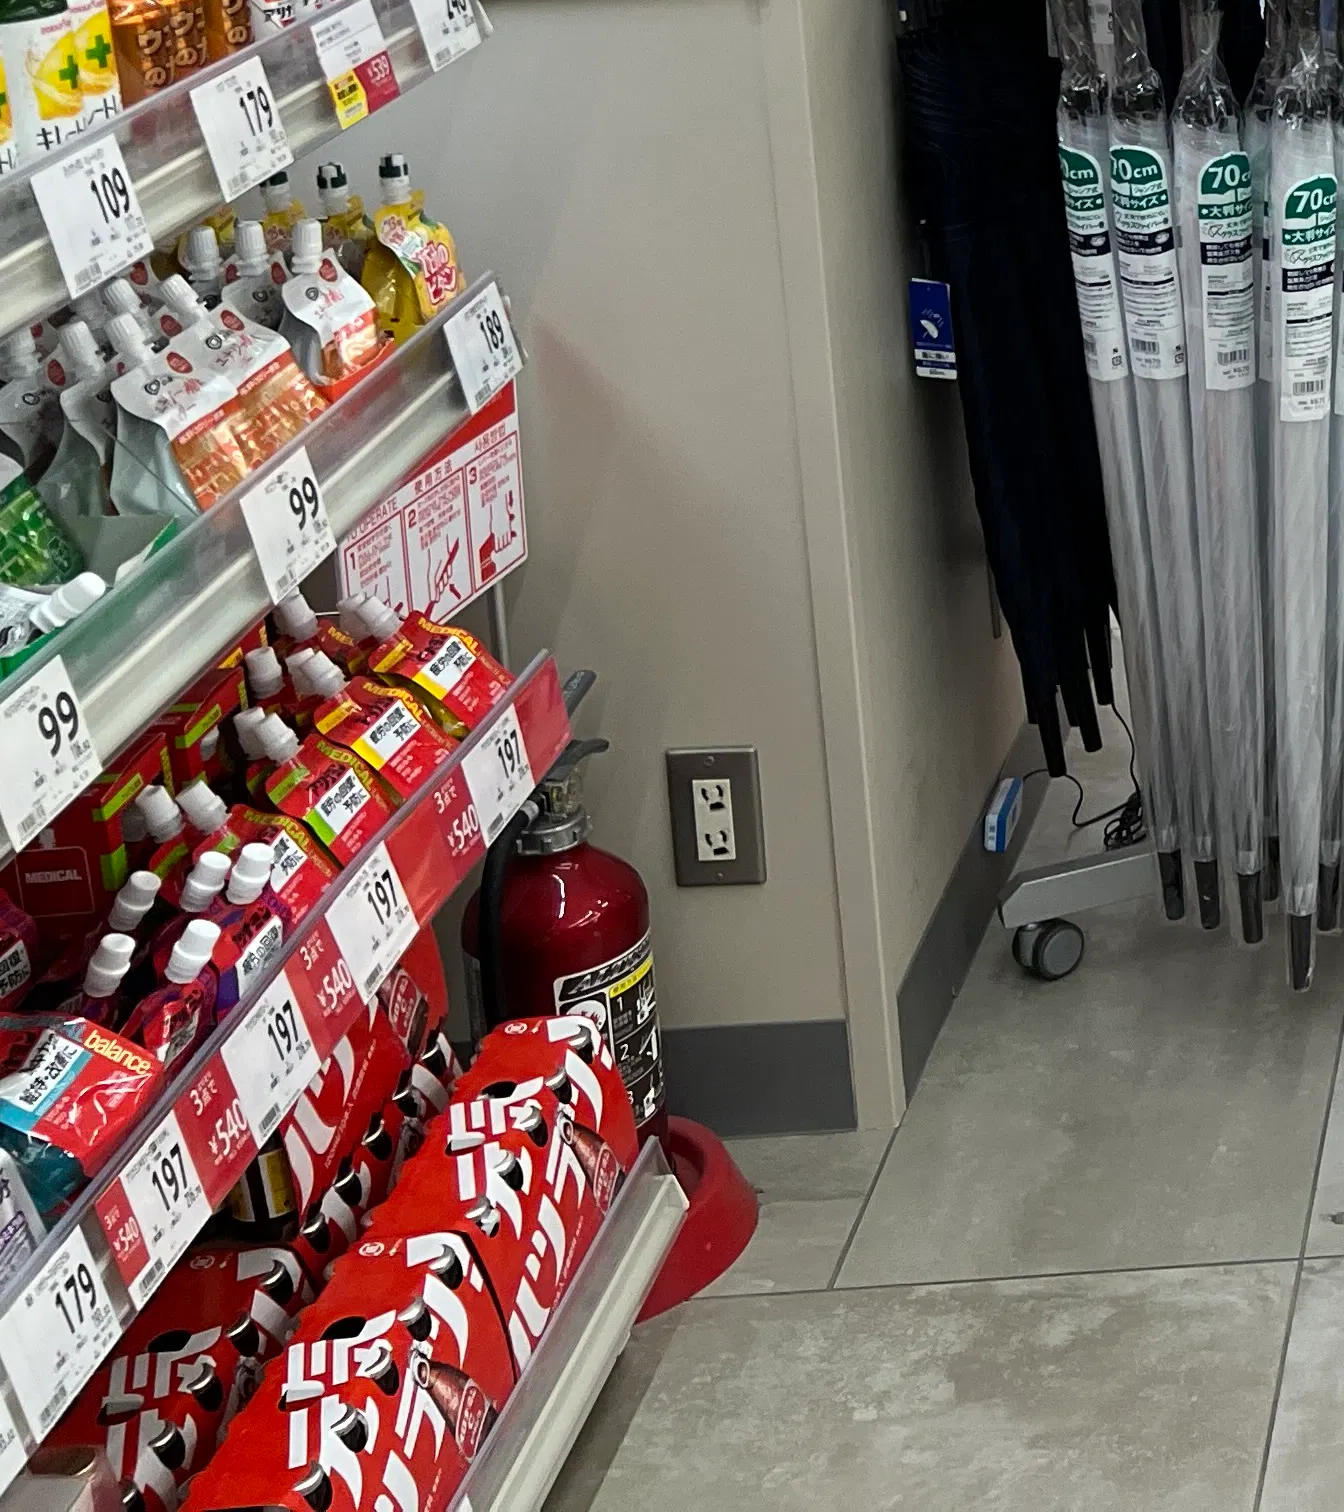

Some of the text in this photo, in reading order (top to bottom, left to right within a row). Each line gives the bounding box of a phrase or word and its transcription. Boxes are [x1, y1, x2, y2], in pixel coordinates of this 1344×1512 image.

[239, 86, 273, 137] 179
[90, 167, 130, 224] 109
[1208, 164, 1250, 188] 70c
[479, 311, 505, 356] 189
[289, 476, 320, 531] 99
[417, 617, 478, 653] MEDICAL
[38, 691, 79, 757] 99
[362, 681, 424, 721] MEDICAL
[316, 741, 375, 791] MEDICAL
[499, 729, 522, 778] 197
[25, 869, 82, 883] MEDICAL
[367, 870, 401, 925] 197
[84, 1029, 152, 1076] balance
[267, 999, 299, 1061] 197
[152, 1144, 188, 1206] 197
[53, 1263, 98, 1335] 179
